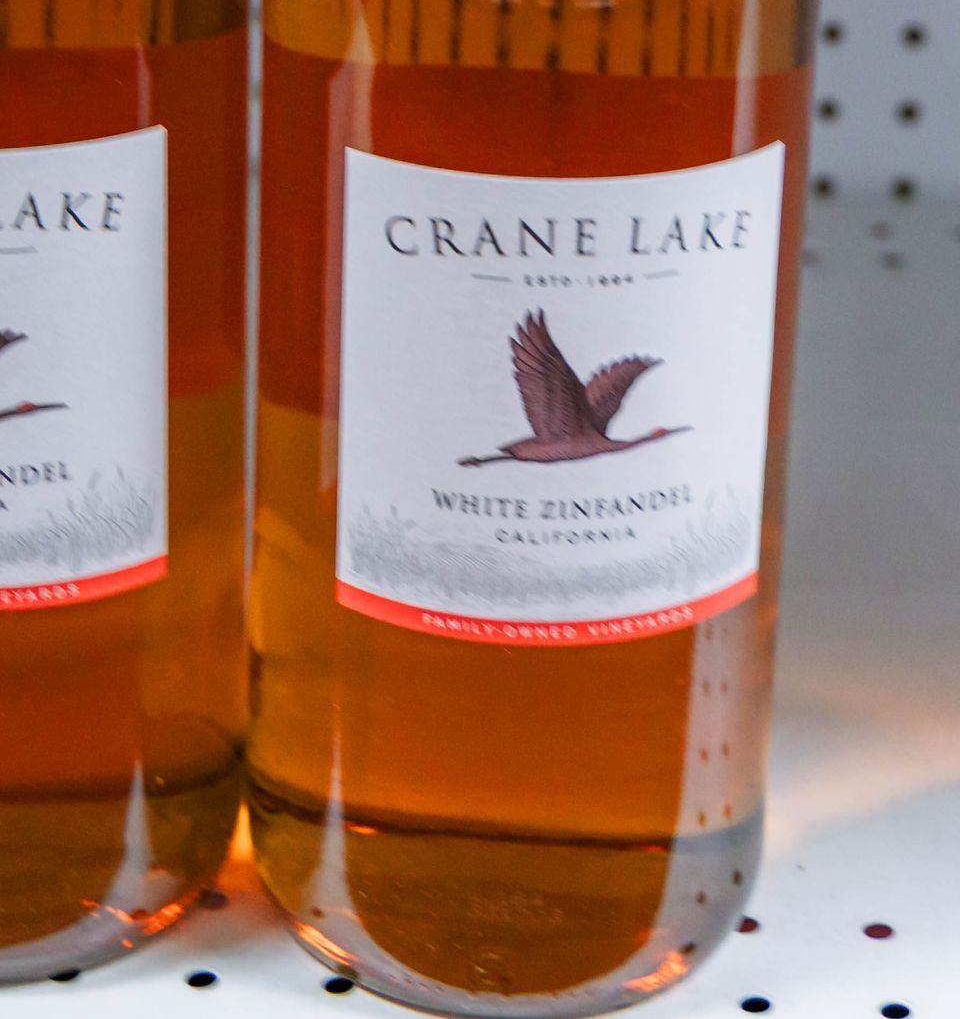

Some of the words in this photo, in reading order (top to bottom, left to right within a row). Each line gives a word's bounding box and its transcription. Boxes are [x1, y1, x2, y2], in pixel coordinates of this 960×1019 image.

[384, 215, 598, 256] CRANE
[629, 210, 751, 255] LAKE
[431, 487, 528, 520] WHITE
[539, 484, 692, 520] ZINFANDEL
[494, 525, 638, 545] CALIFORNIA
